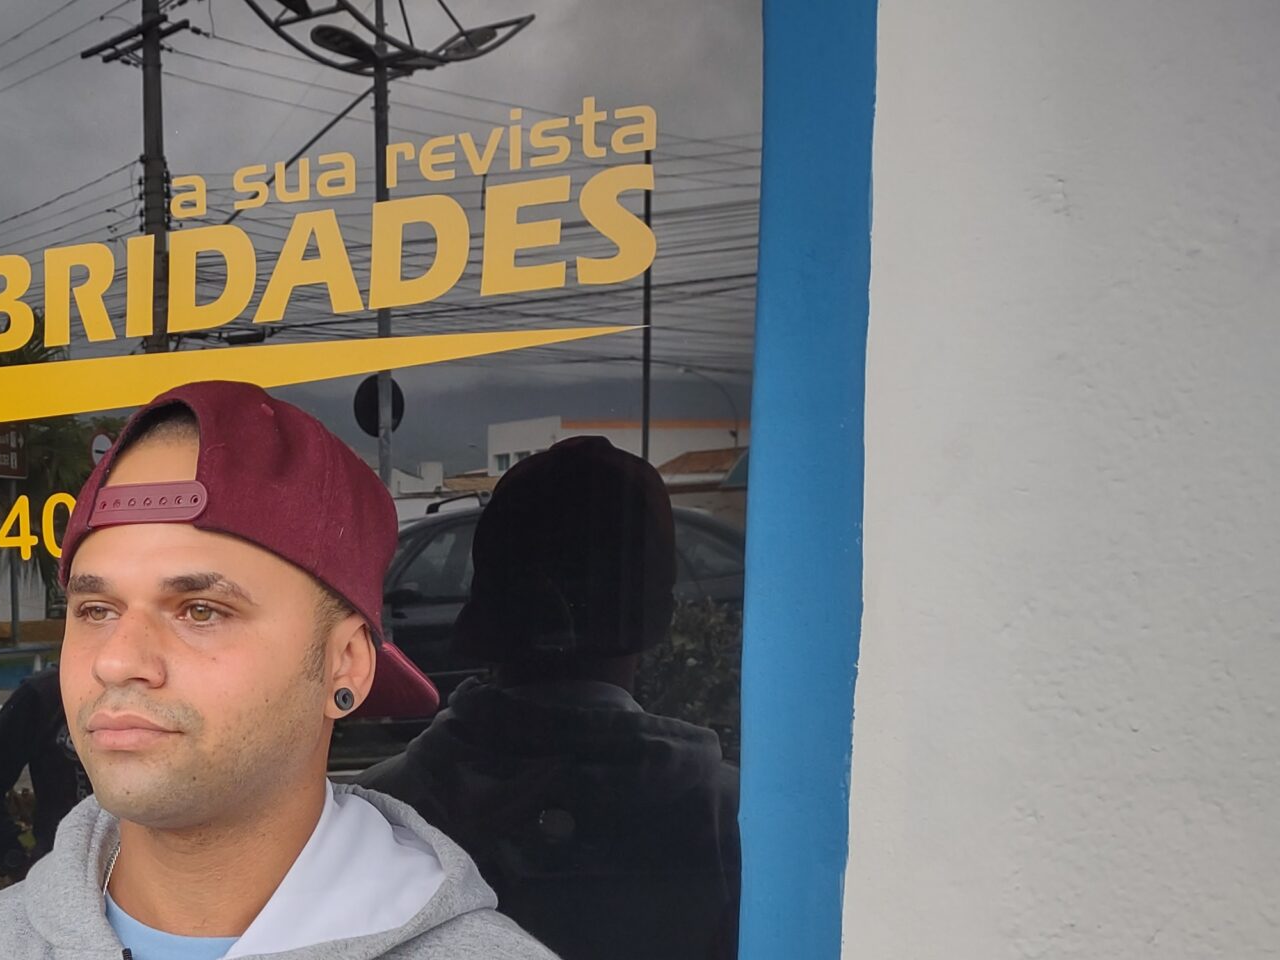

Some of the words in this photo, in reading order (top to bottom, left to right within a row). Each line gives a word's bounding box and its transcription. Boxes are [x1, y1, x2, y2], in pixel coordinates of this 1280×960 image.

[169, 174, 207, 219] a
[232, 151, 356, 210] sua
[385, 96, 657, 189] revista
